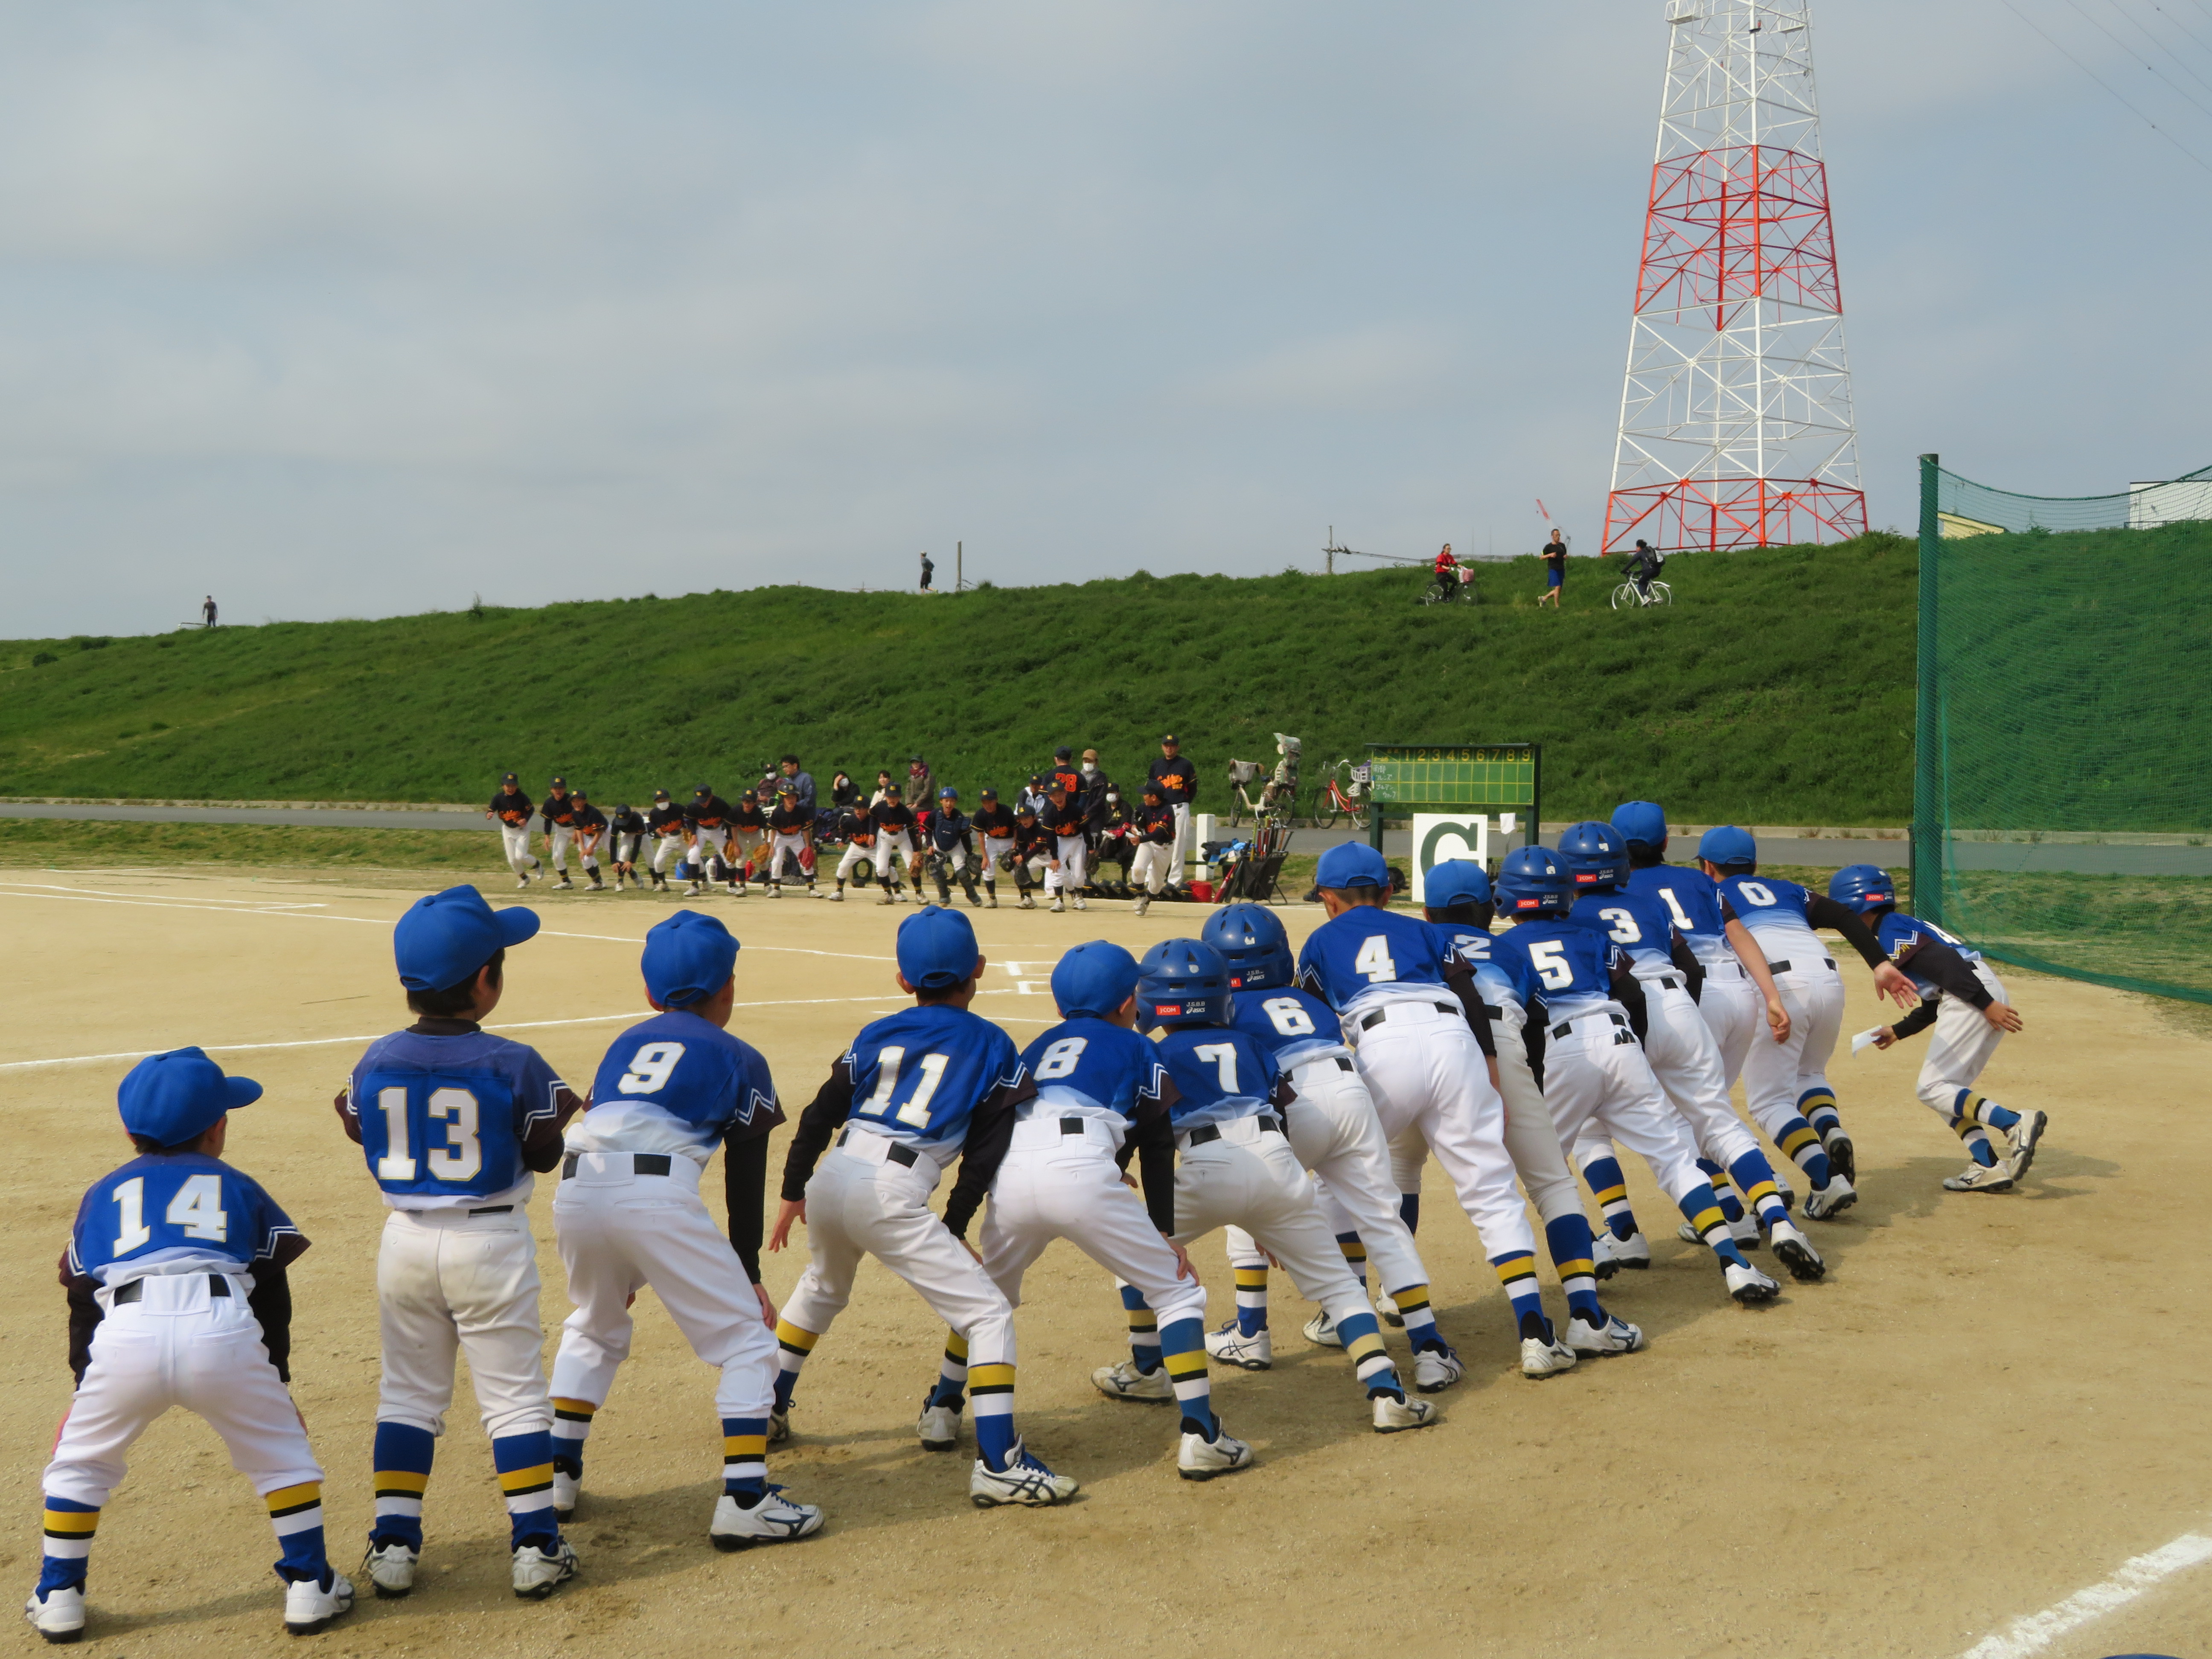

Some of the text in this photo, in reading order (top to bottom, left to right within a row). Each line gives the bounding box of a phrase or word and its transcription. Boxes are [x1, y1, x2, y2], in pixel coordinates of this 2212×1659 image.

[1406, 749, 1409, 761] 1
[1417, 748, 1426, 761] 2
[1432, 748, 1441, 761] 3
[1447, 749, 1455, 761] 4
[1461, 749, 1470, 761] 5
[1476, 748, 1485, 761] 6
[1492, 749, 1500, 761] 7
[1507, 748, 1515, 762] 8
[1522, 748, 1531, 762] 9
[1420, 822, 1479, 878] G
[1658, 888, 1694, 930] 1
[1738, 882, 1777, 906] 0
[1454, 934, 1491, 959] 2
[1598, 908, 1642, 944] 3
[1355, 934, 1397, 983] 4
[1528, 940, 1574, 990] 5
[1262, 997, 1316, 1036] 6
[617, 1042, 687, 1094] 9
[1033, 1036, 1088, 1082] 8
[1193, 1042, 1240, 1094] 7
[859, 1045, 950, 1129] 11
[378, 1086, 482, 1182] 13
[112, 1174, 227, 1258] 14
